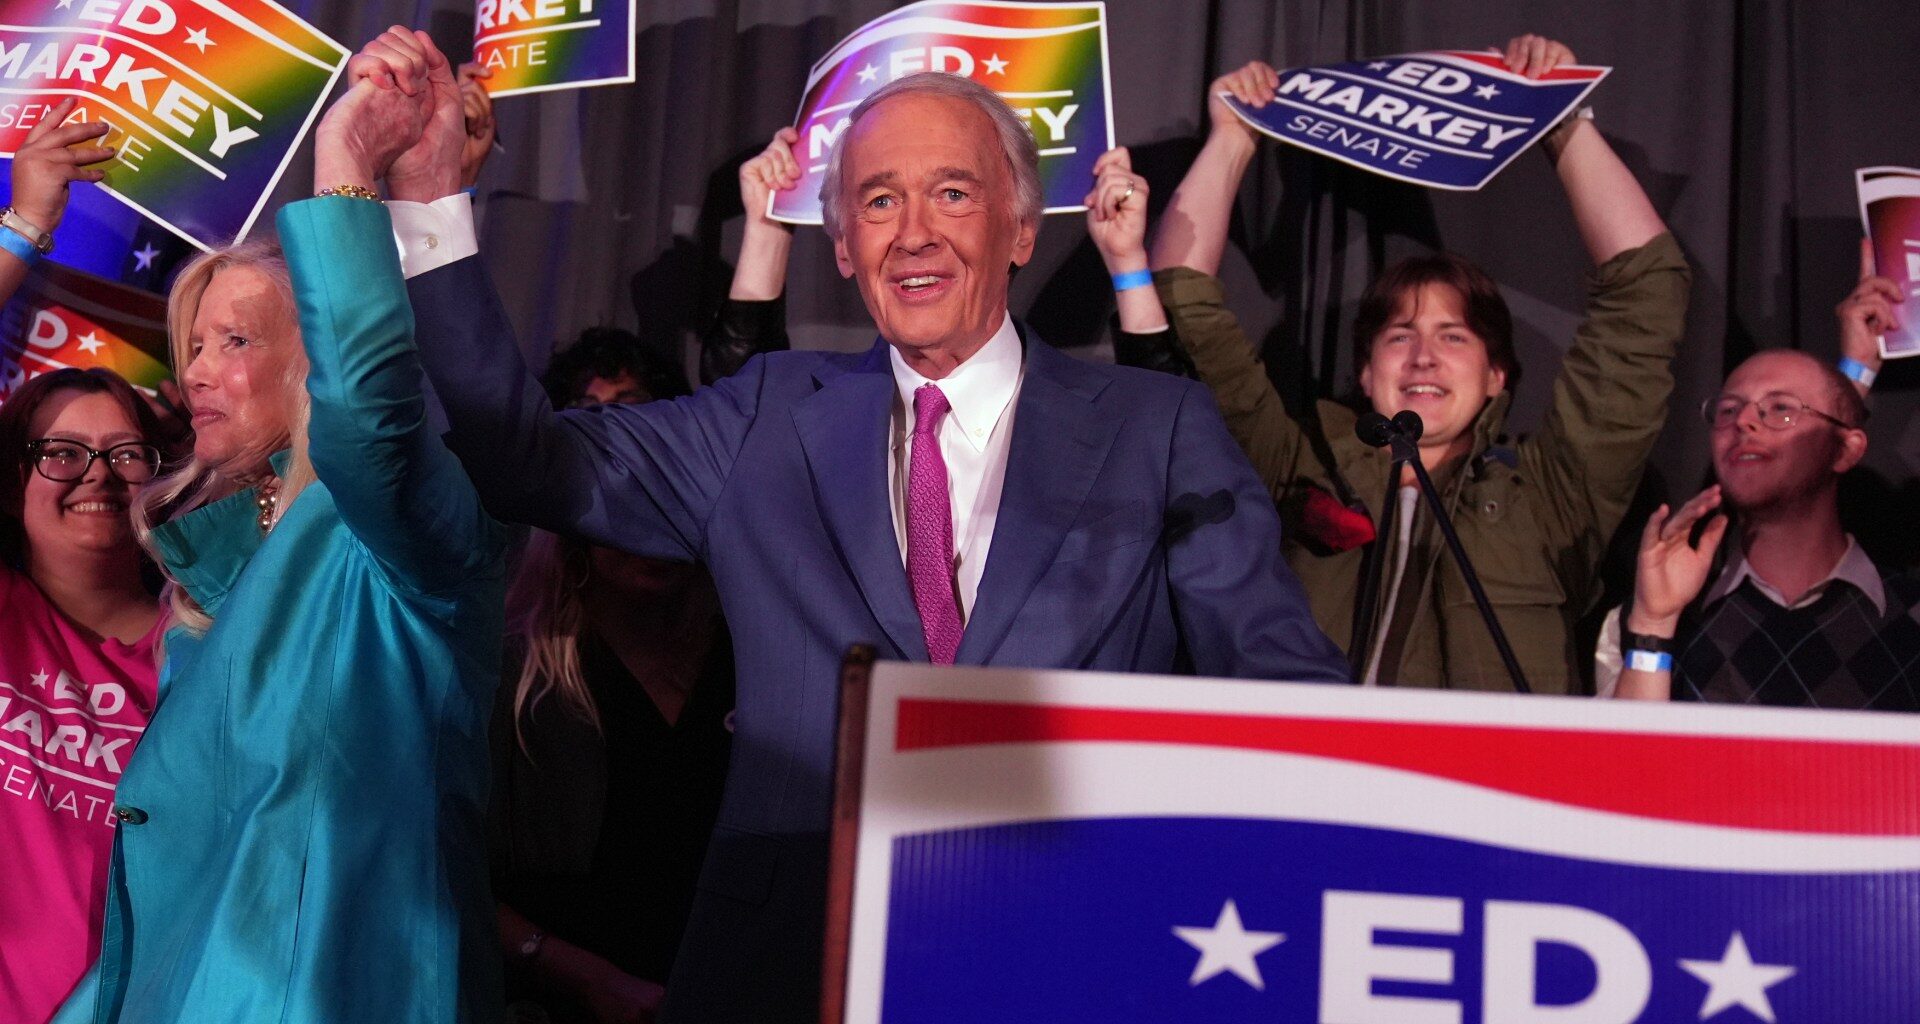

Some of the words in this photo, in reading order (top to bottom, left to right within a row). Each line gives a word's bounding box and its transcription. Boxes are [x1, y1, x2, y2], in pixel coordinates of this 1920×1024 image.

[79, 0, 177, 35] ED
[889, 46, 975, 80] ED
[1386, 61, 1472, 95] ED
[0, 41, 260, 159] MARKEY
[1279, 73, 1529, 150] MARKEY
[1287, 115, 1430, 169] SENATE
[54, 669, 125, 716] ED
[0, 758, 117, 828] ENATE
[1319, 889, 1652, 1024] ED
